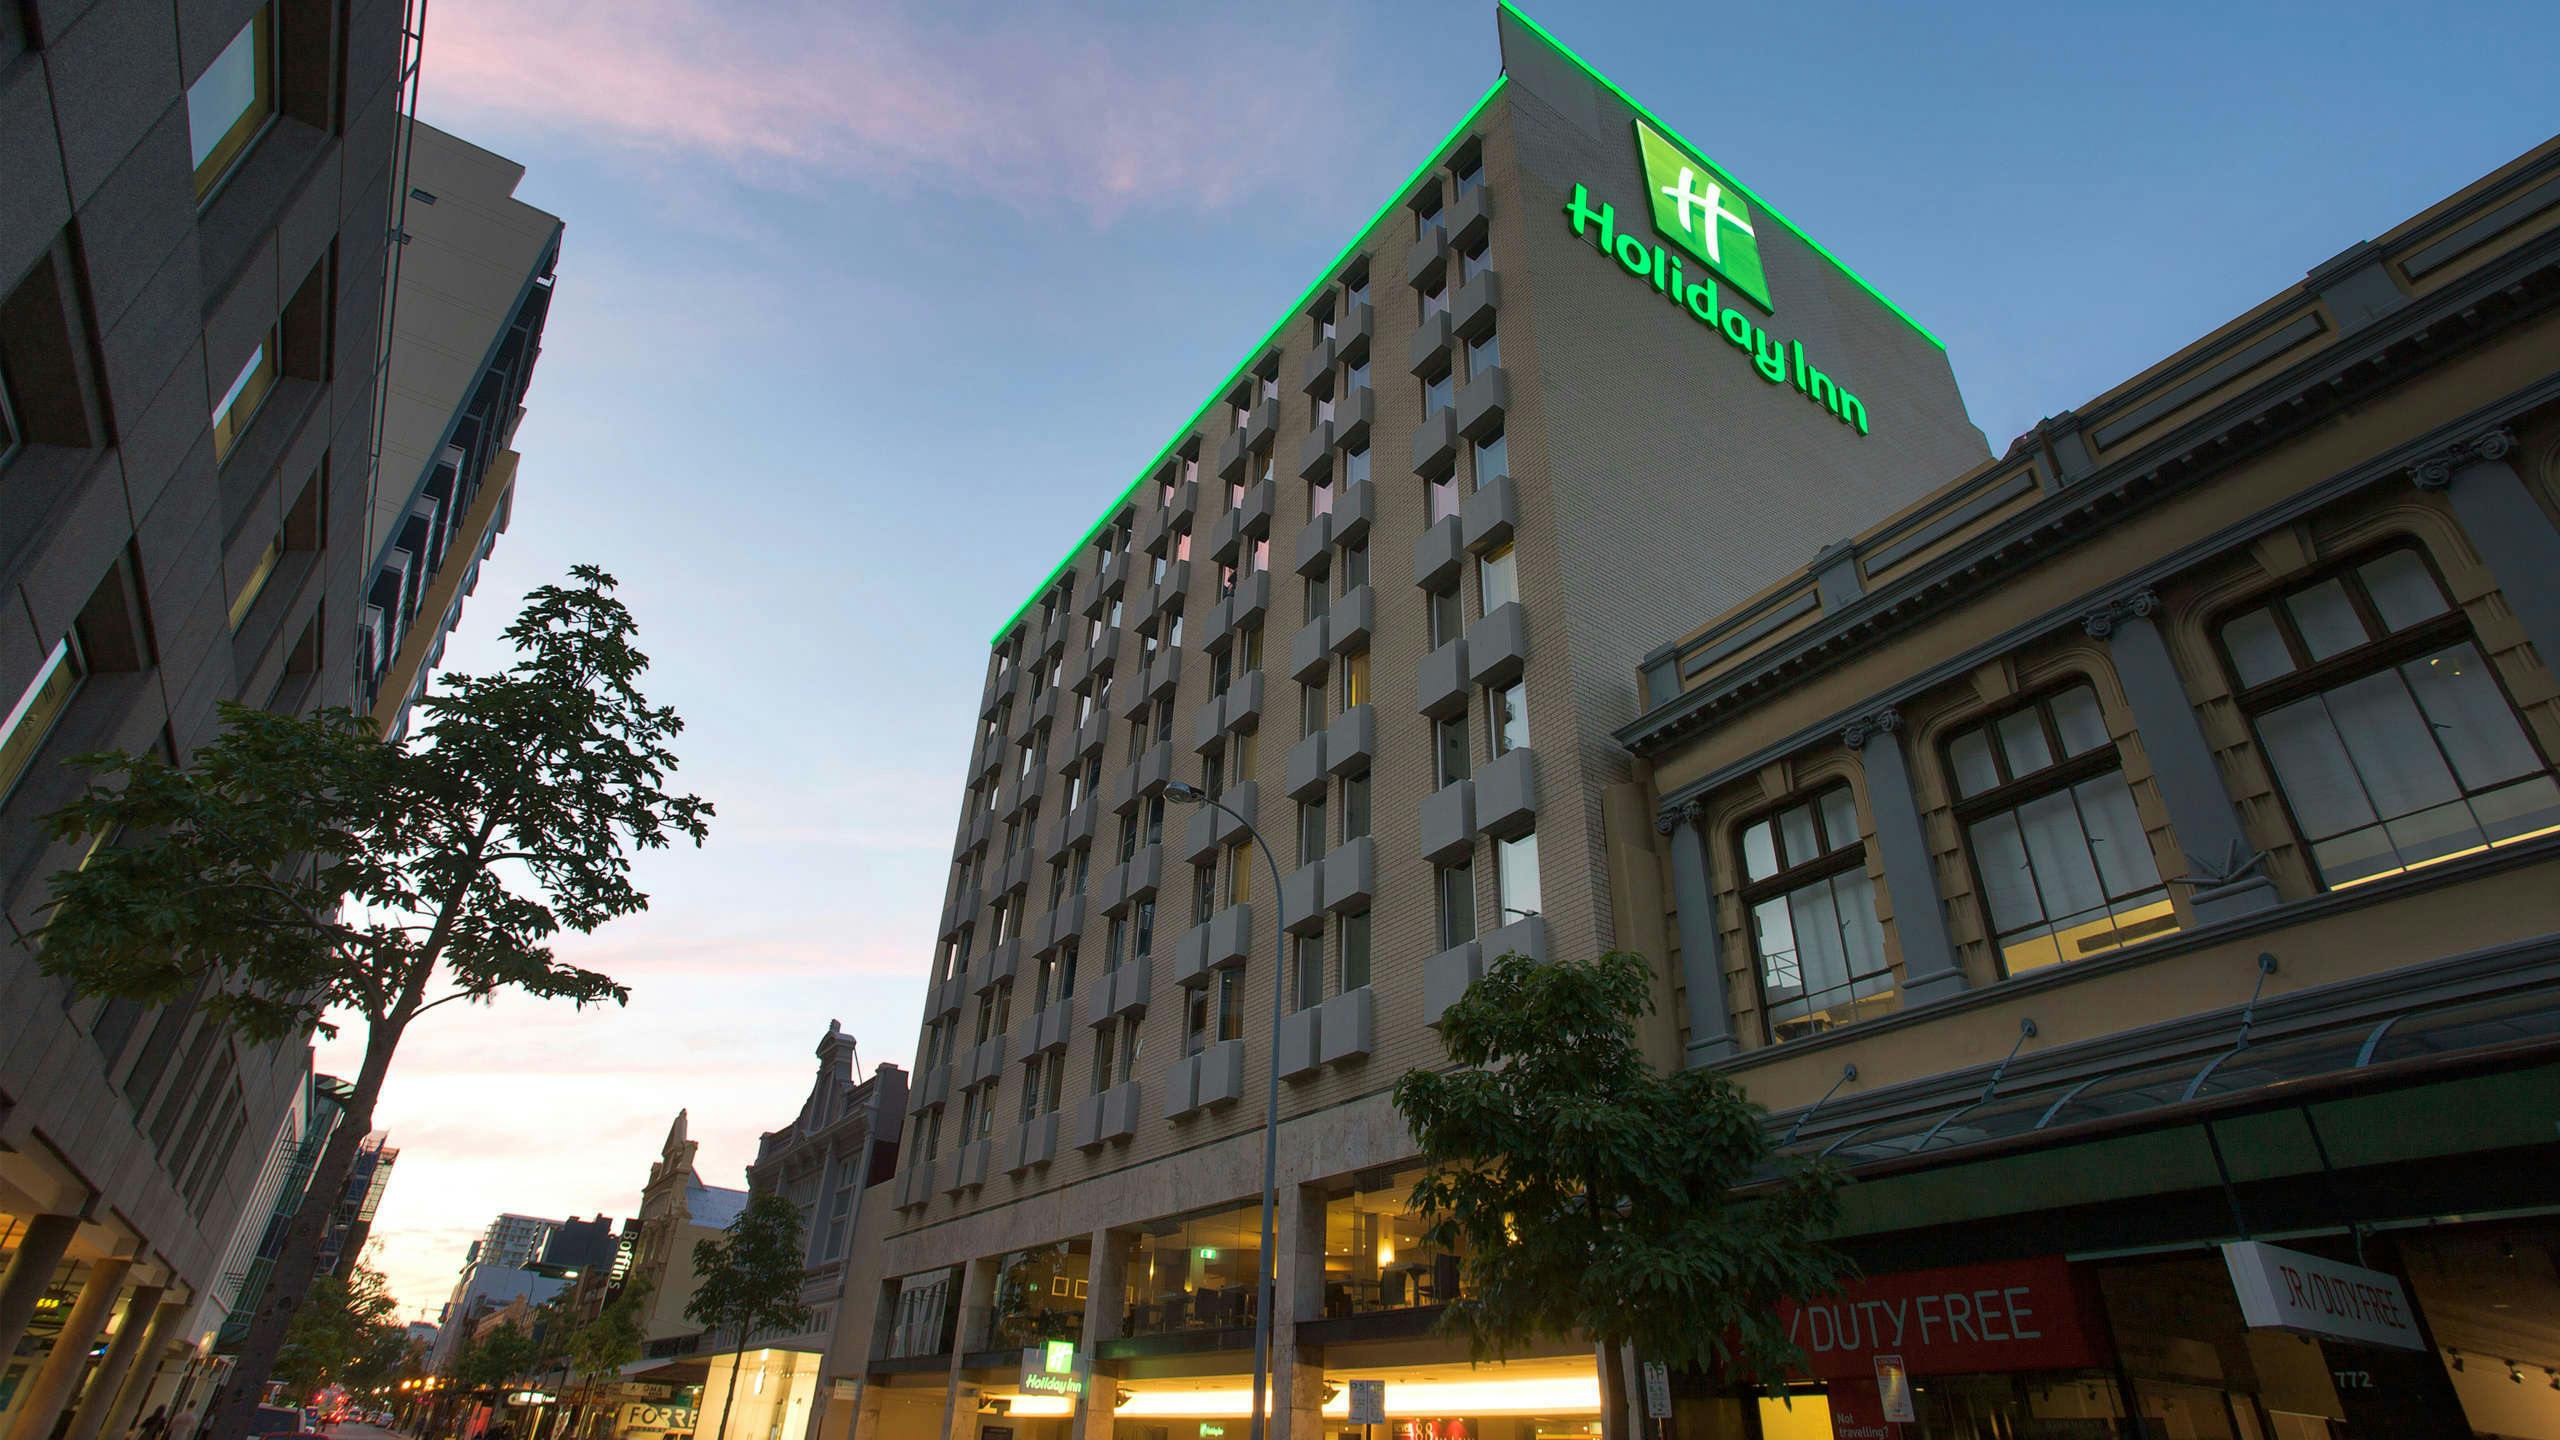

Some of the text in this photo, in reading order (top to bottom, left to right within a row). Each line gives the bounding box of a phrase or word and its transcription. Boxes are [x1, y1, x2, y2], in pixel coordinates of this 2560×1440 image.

[1563, 182, 1869, 436] Holiday Inn
[608, 1231, 638, 1289] Boffins
[1026, 1374, 1082, 1394] Holiday Inn
[2334, 1371, 2373, 1388] 772
[1838, 1412, 1855, 1424] Not
[1839, 1425, 1889, 1440] travelling?
